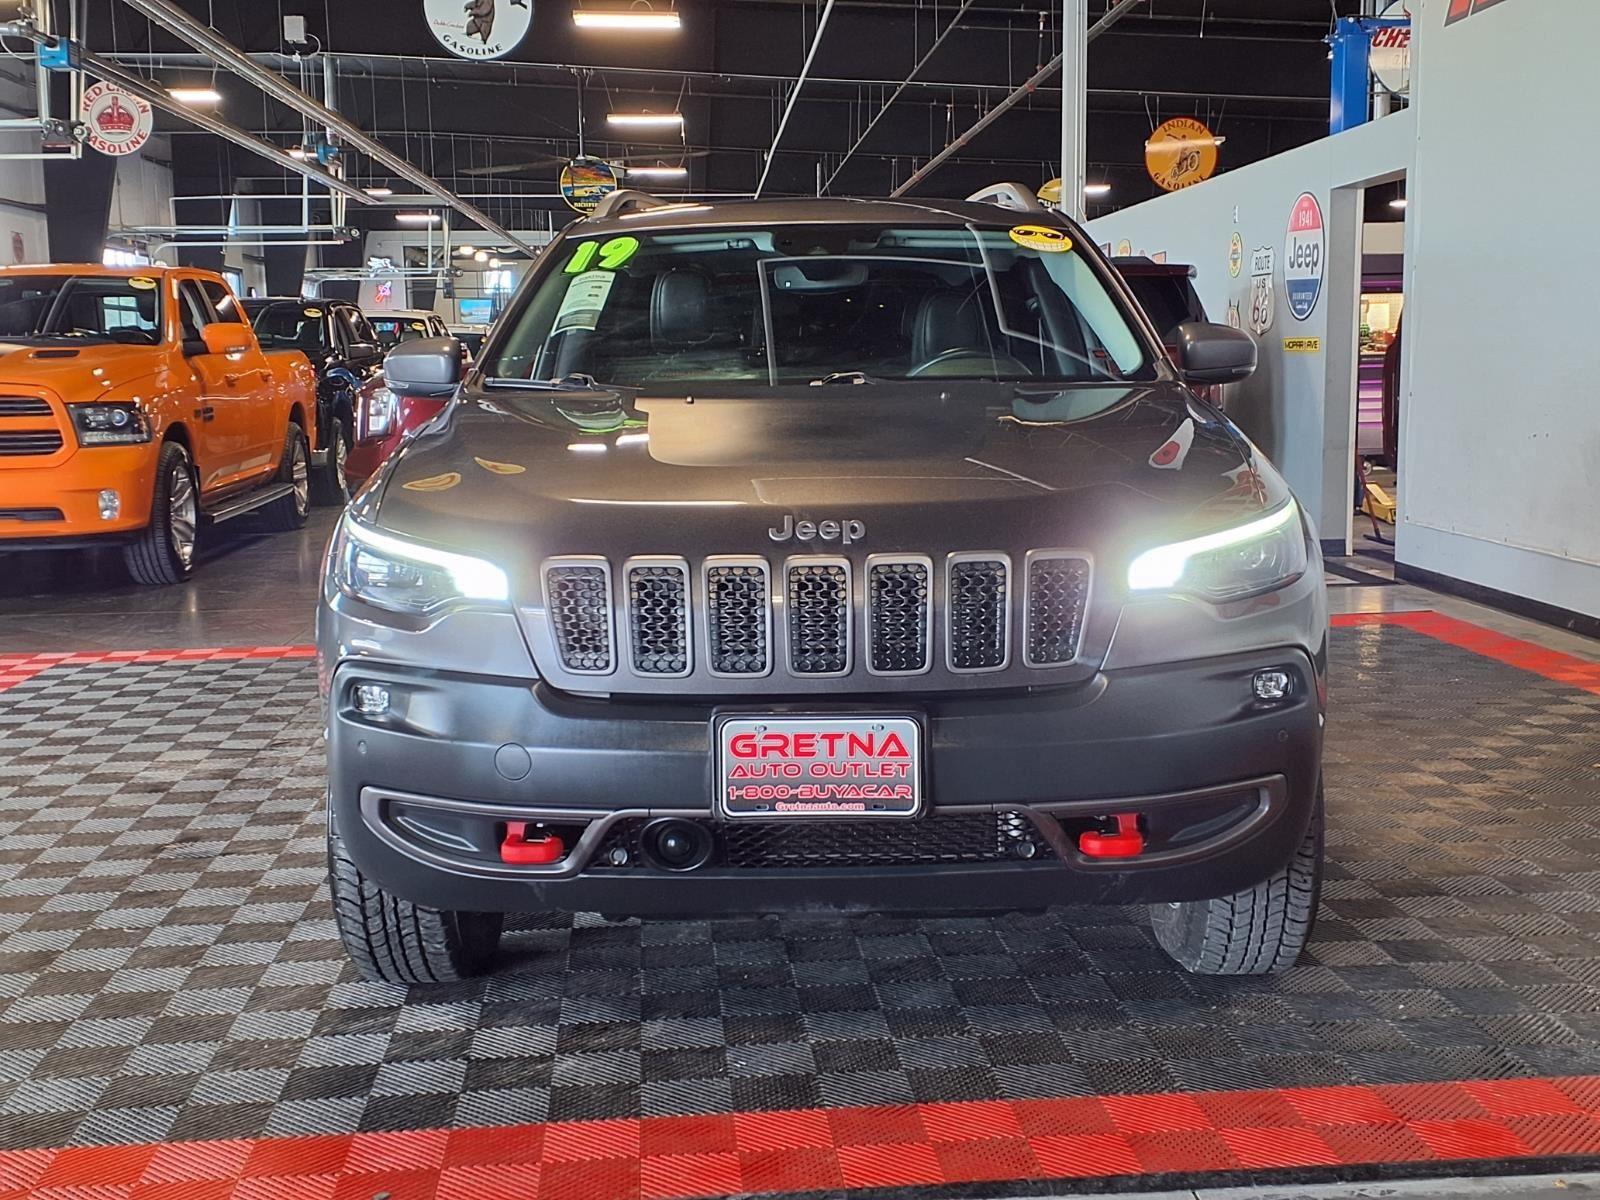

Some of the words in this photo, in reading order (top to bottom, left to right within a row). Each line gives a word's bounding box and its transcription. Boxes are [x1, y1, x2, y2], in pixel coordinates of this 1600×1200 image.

[443, 34, 503, 55] GASOLINE
[1162, 119, 1204, 134] INDIAN
[1299, 209, 1313, 227] 1941
[563, 236, 639, 273] 19
[1255, 255, 1271, 271] ROUTE
[1289, 237, 1320, 275] Jeep
[1256, 278, 1267, 289] US
[1252, 291, 1268, 324] 66
[768, 515, 866, 544] Jeep
[729, 732, 911, 759] GRETNA
[729, 763, 801, 778] AUTO
[809, 762, 912, 778] OUTLET
[728, 784, 912, 800] 1-800-BUYACAR
[775, 801, 865, 811] Gretnaauto.com
